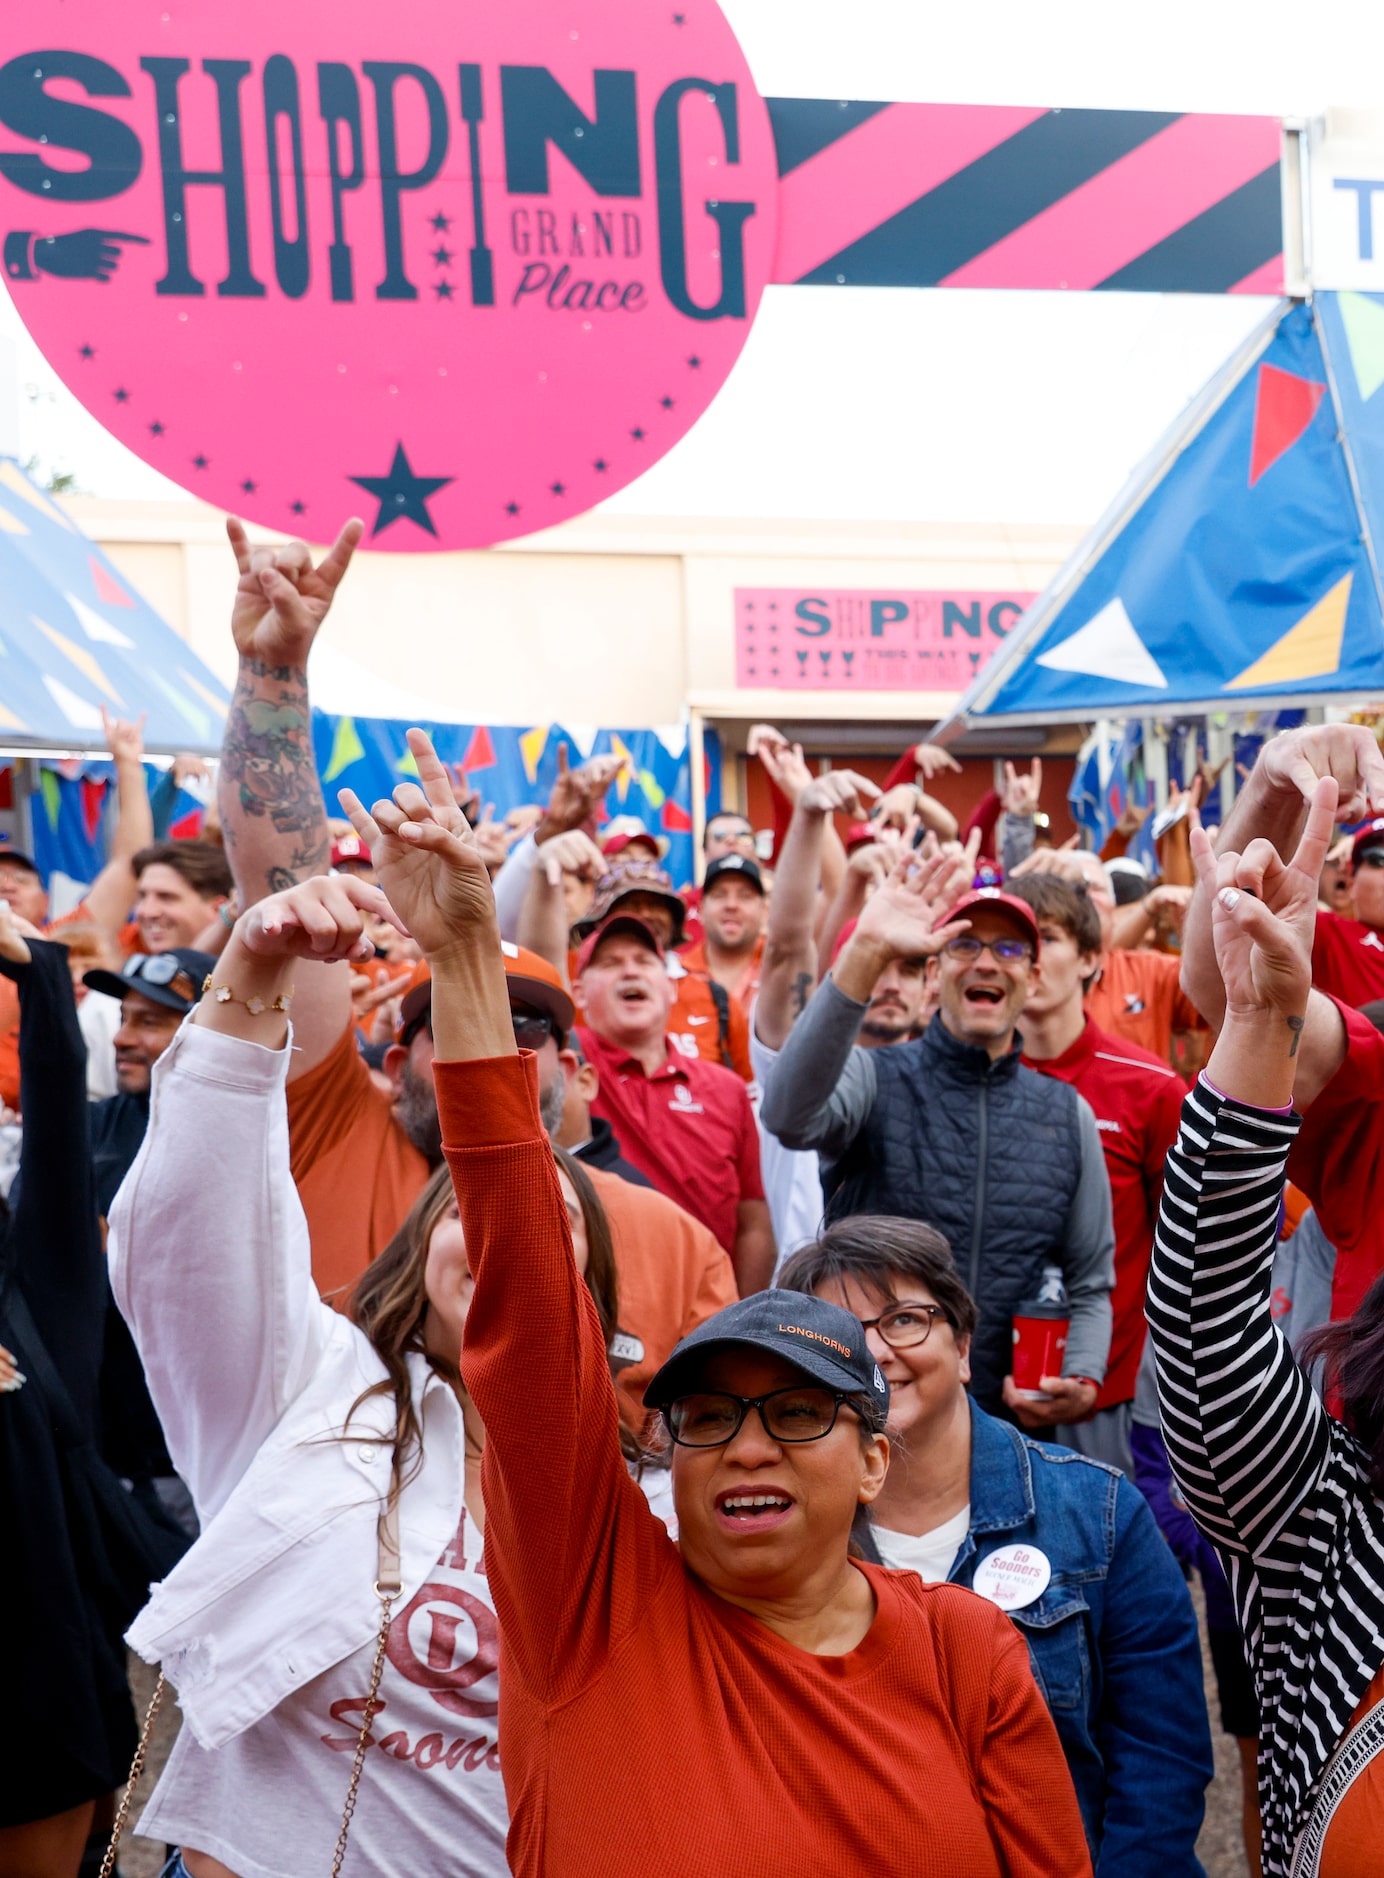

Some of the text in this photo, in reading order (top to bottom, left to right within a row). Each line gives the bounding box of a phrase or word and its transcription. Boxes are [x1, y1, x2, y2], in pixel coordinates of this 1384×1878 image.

[0, 49, 757, 322] SHOPPING
[511, 208, 643, 259] GRAND
[511, 262, 648, 314] Place
[778, 1323, 852, 1359] LONGHORNS
[990, 1556, 1043, 1578] Sooners
[1013, 1550, 1030, 1563] Go
